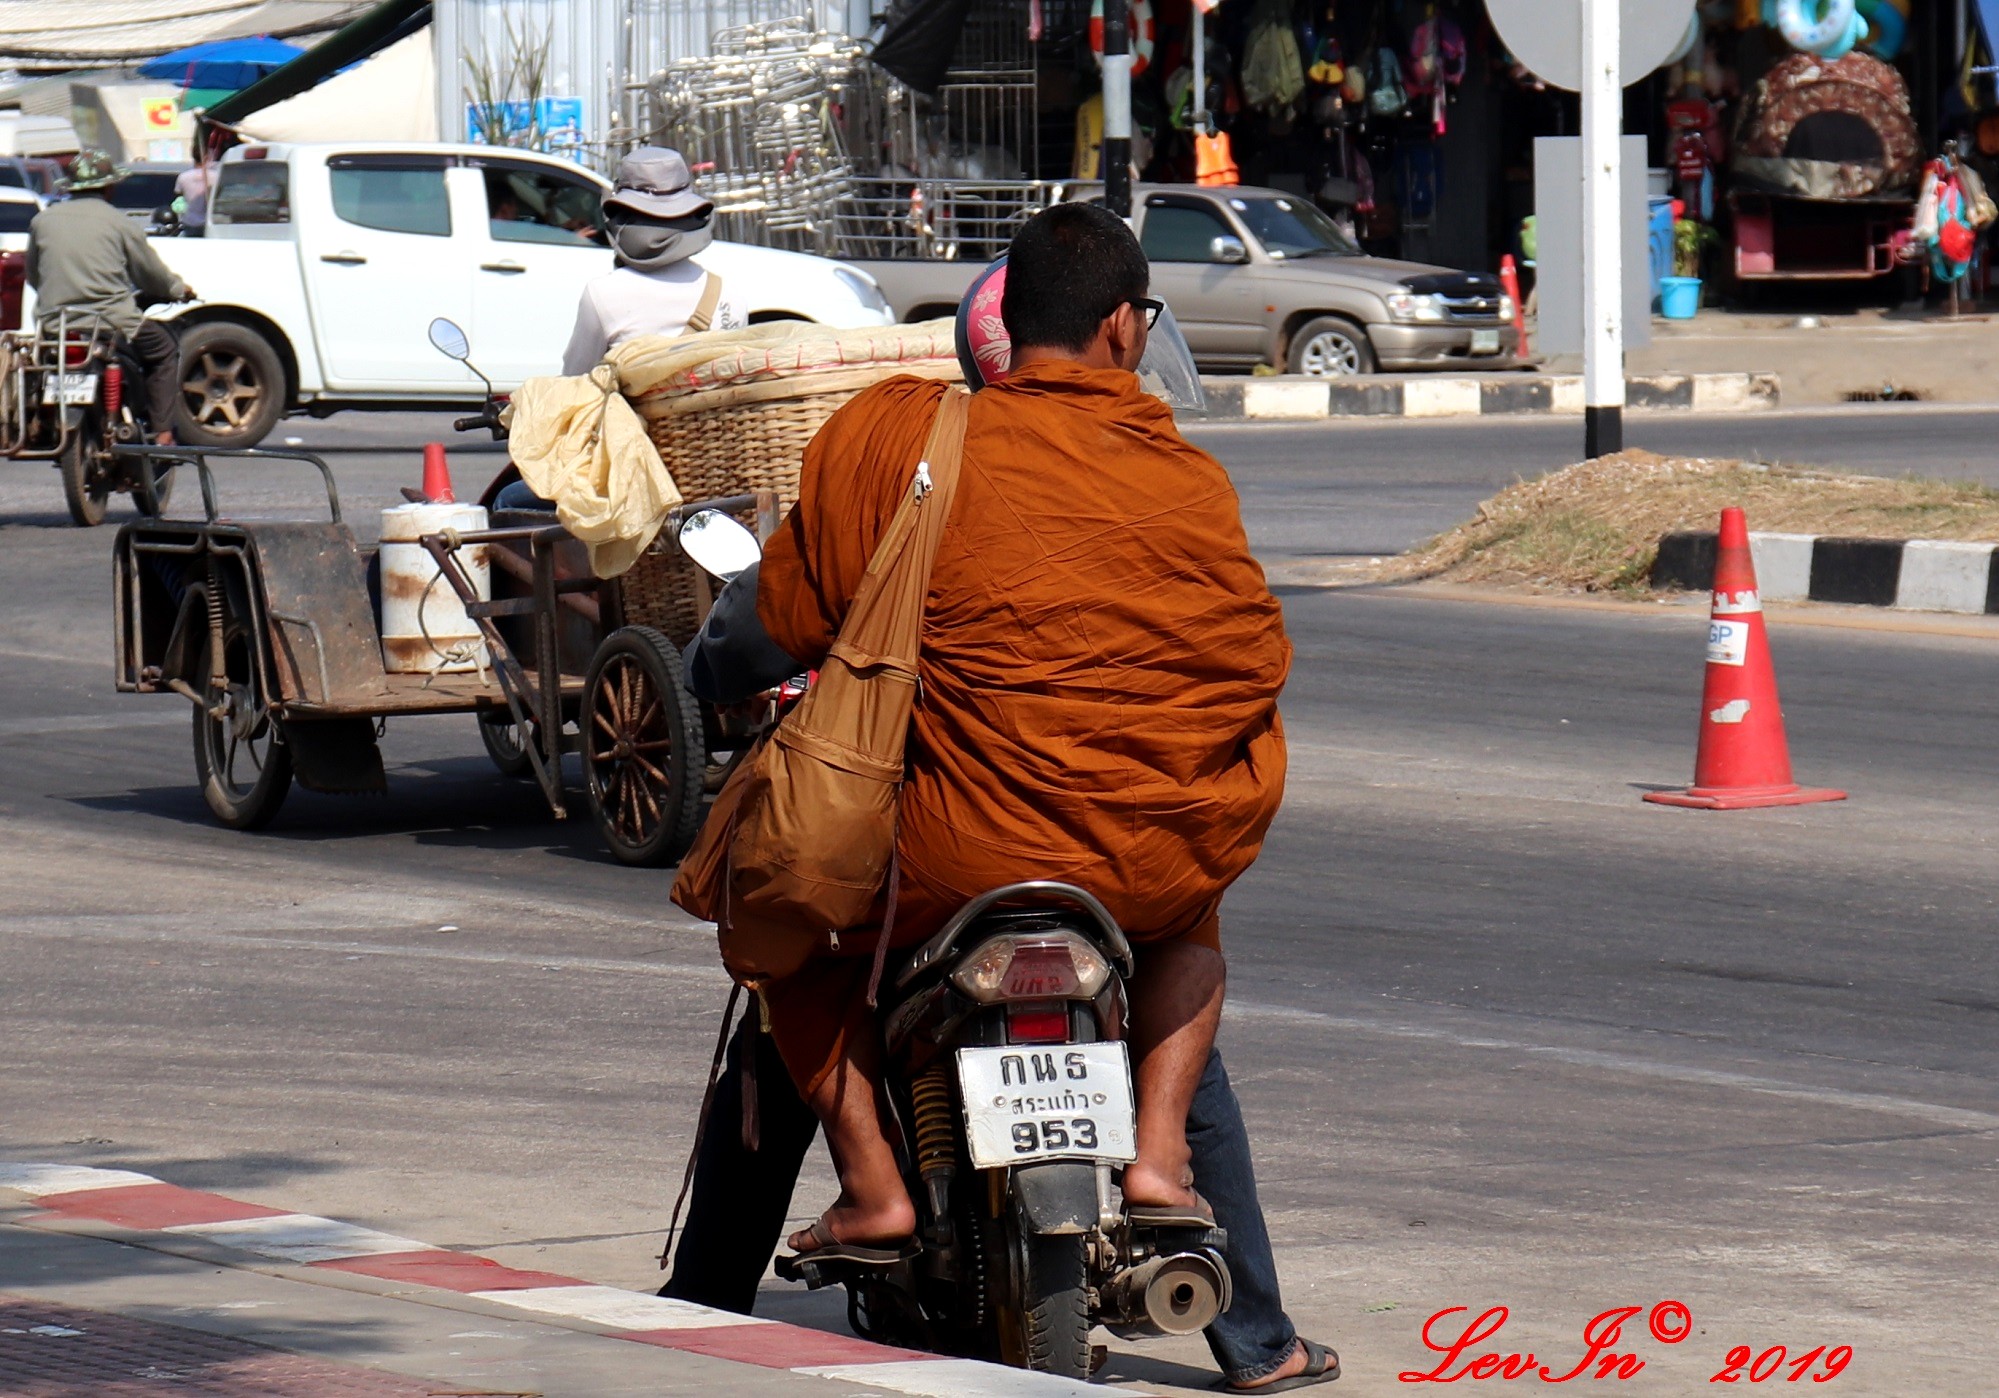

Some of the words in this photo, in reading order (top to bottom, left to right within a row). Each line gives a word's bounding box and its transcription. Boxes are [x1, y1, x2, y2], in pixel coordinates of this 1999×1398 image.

[1000, 1053, 1087, 1086] กนธ
[1011, 1089, 1090, 1115] สระแก้ว
[1011, 1118, 1100, 1153] 953
